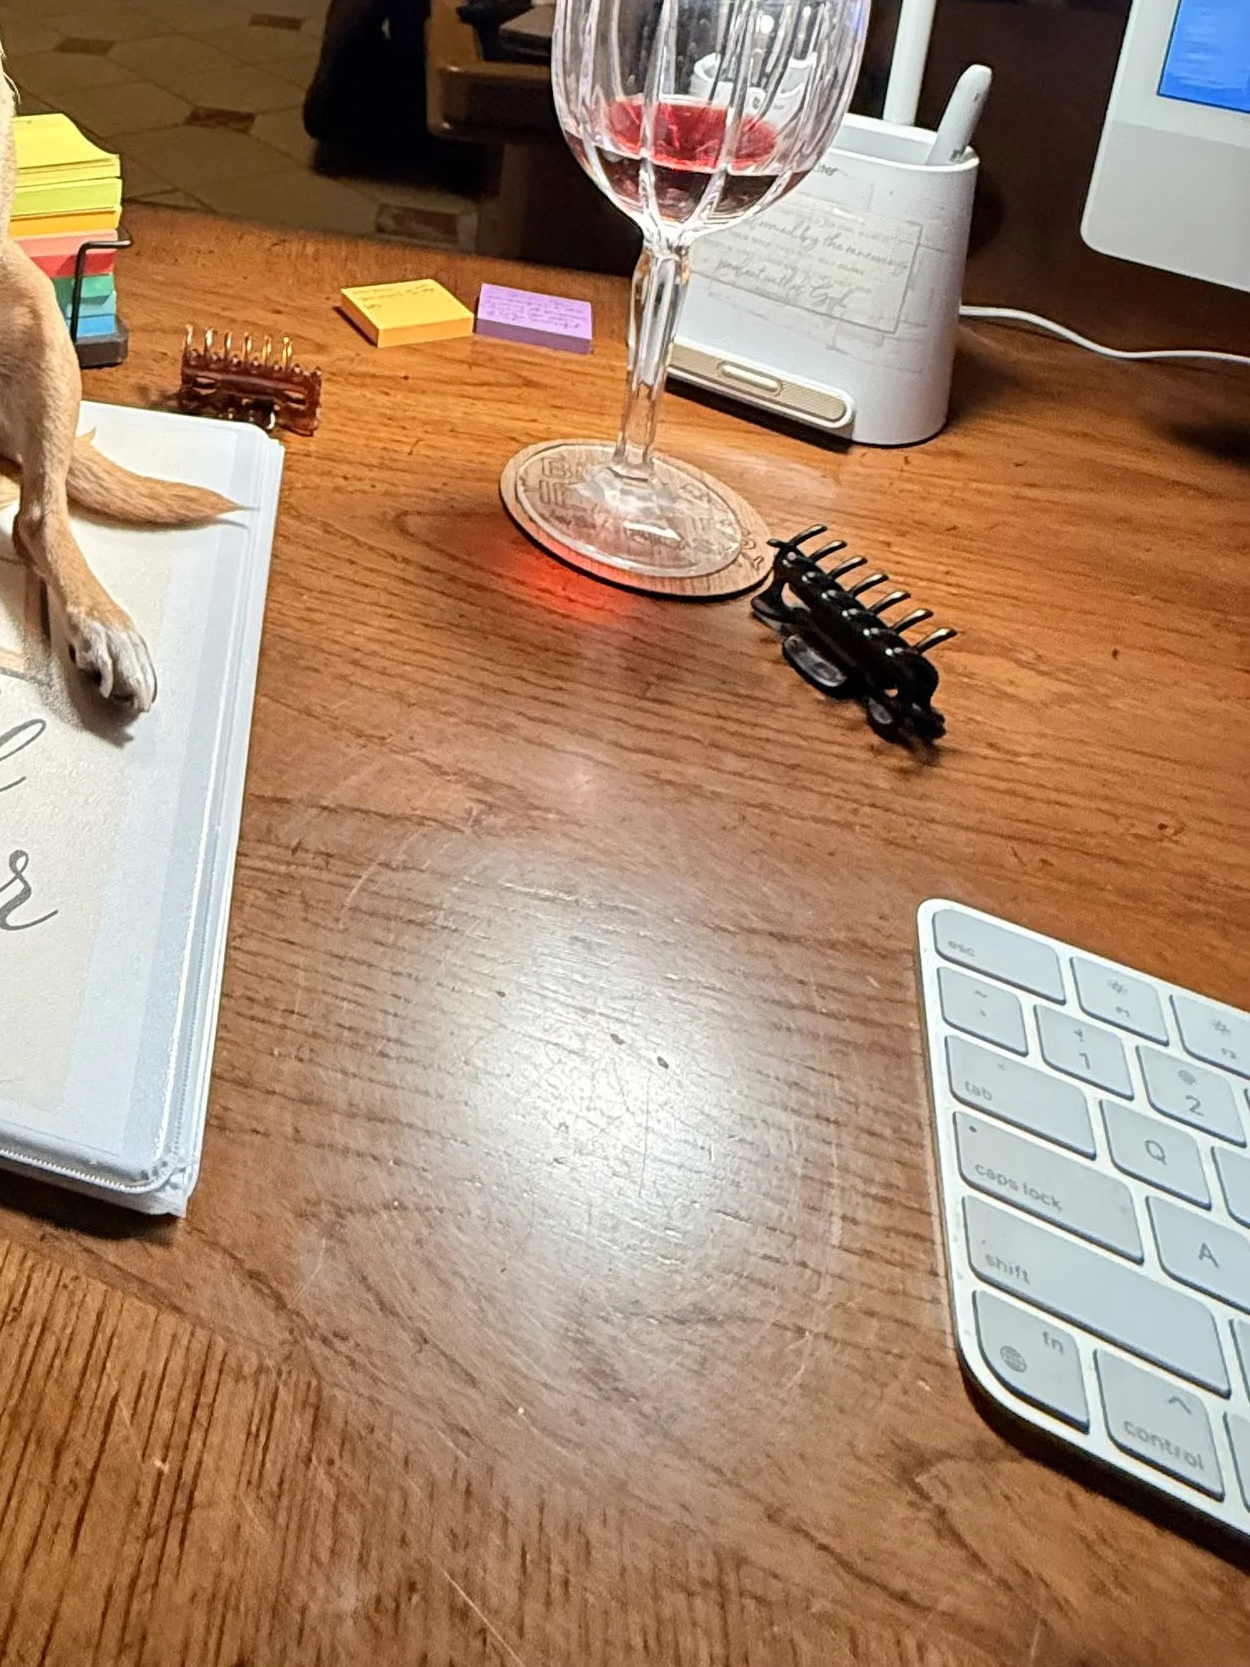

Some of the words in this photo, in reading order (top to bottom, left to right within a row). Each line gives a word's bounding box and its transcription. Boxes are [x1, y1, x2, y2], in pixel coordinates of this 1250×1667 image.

[948, 939, 976, 958] esc
[964, 1079, 993, 1102] tab
[1184, 1094, 1205, 1117] 2
[1144, 1138, 1168, 1166] Q
[974, 1163, 1019, 1191] caps
[1021, 1182, 1063, 1211] lock
[984, 1253, 1030, 1284] shift
[1198, 1242, 1220, 1269] A
[1042, 1330, 1065, 1355] fn
[1123, 1420, 1205, 1470] control
